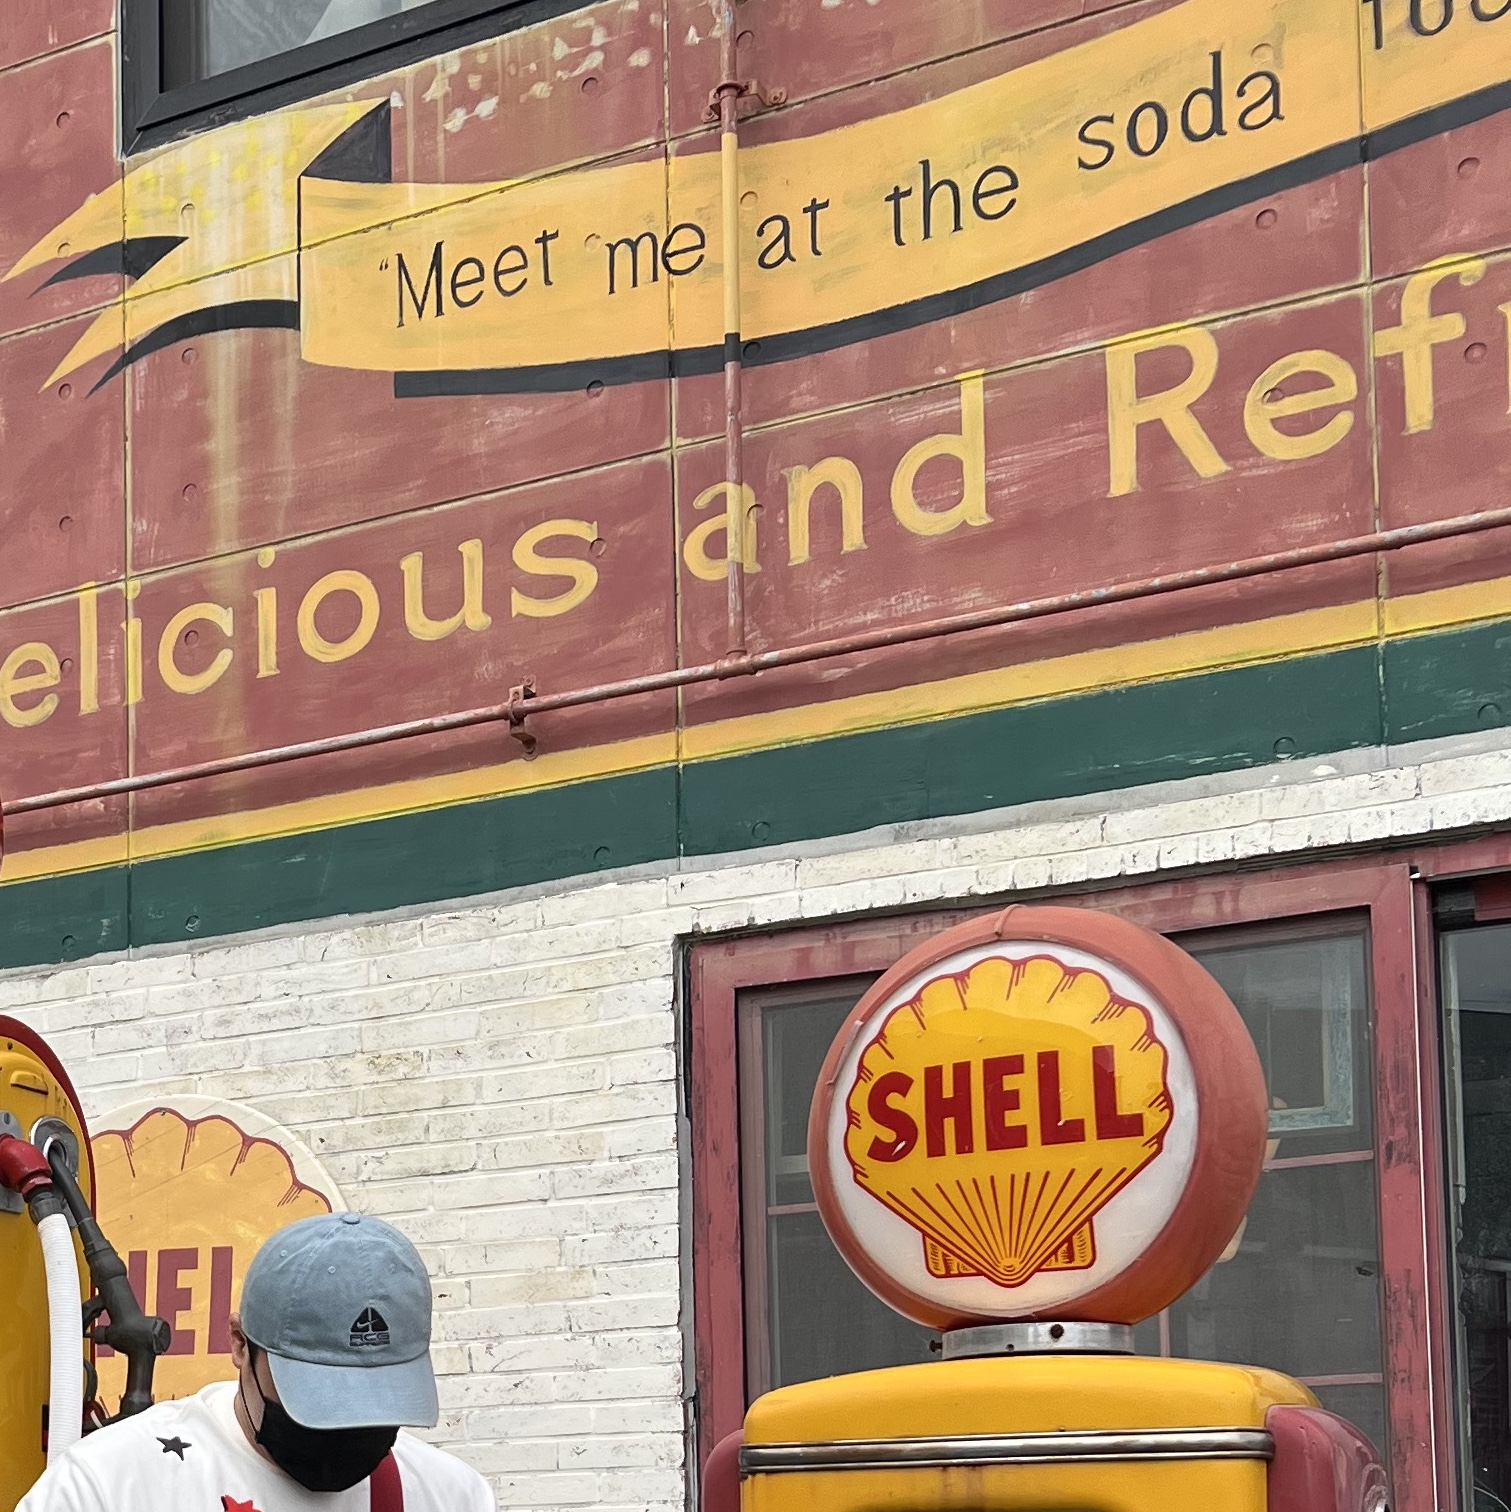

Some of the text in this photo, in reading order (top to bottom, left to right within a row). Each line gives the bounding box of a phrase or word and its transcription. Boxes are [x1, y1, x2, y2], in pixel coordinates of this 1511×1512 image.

[607, 222, 705, 296] me
[756, 197, 829, 270] at
[885, 159, 1020, 248] the
[1077, 50, 1285, 171] soda
[682, 368, 994, 583] and
[1104, 253, 1511, 498] Ref
[867, 1045, 1144, 1163] SHELL
